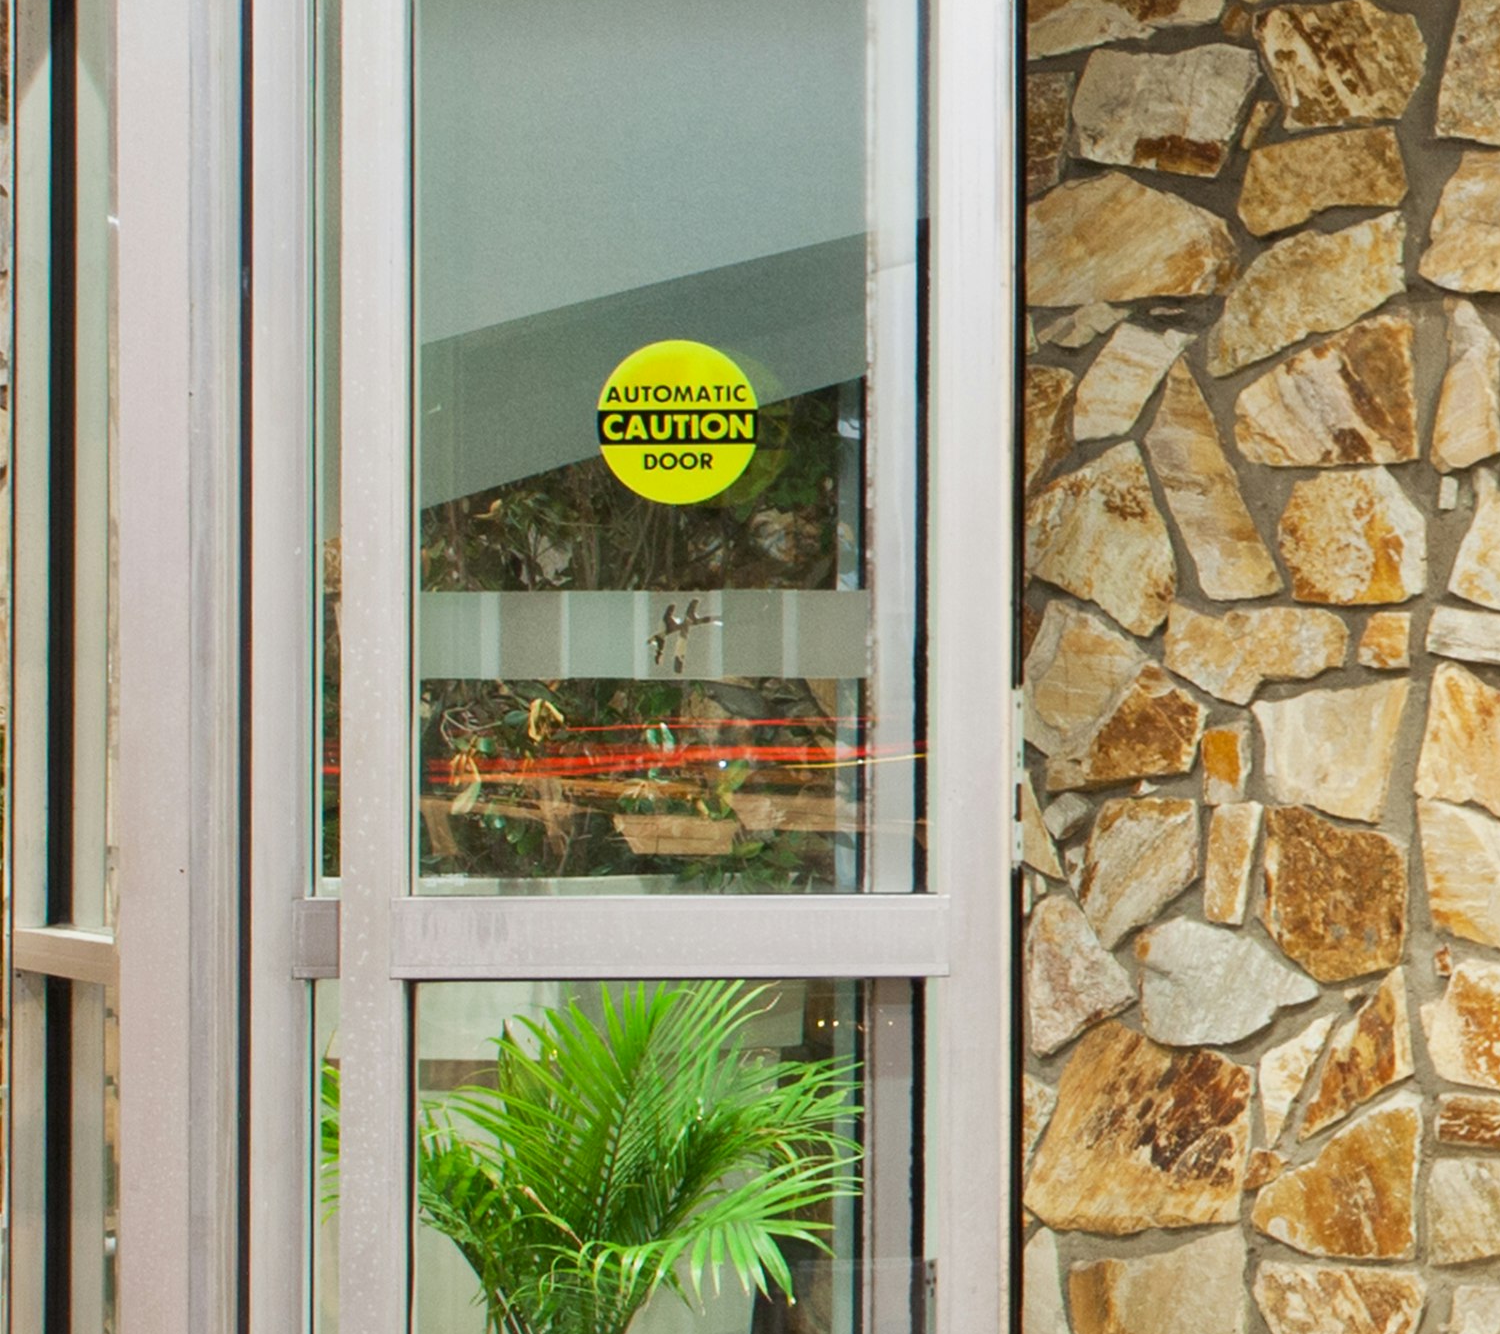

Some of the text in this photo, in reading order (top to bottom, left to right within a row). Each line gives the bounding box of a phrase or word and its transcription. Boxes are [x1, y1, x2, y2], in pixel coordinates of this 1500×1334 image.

[606, 384, 747, 403] AUTOMATIC
[602, 412, 754, 441] CAUTION
[643, 452, 713, 470] DOOR
